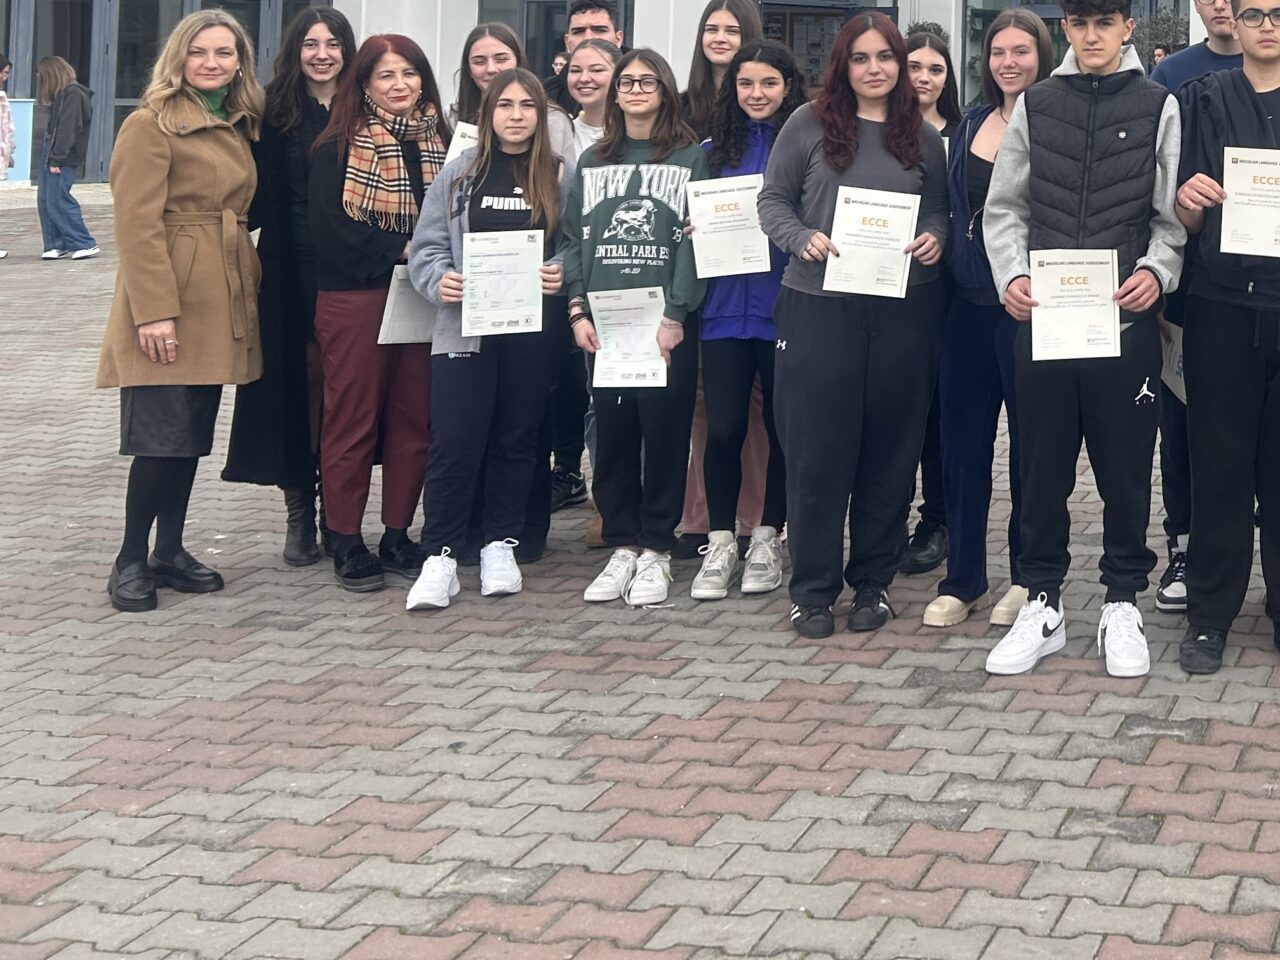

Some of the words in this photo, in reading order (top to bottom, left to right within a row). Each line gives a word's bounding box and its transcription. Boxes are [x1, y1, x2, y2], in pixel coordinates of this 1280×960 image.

[1252, 175, 1280, 186] ECCE
[581, 163, 636, 216] NEW
[639, 163, 692, 222] YORK
[714, 202, 740, 213] ECCE
[861, 216, 889, 228] ECCE
[594, 244, 629, 258] ENTRAL
[631, 244, 657, 258] PARK
[659, 246, 670, 260] ES
[1060, 276, 1089, 286] ECCE
